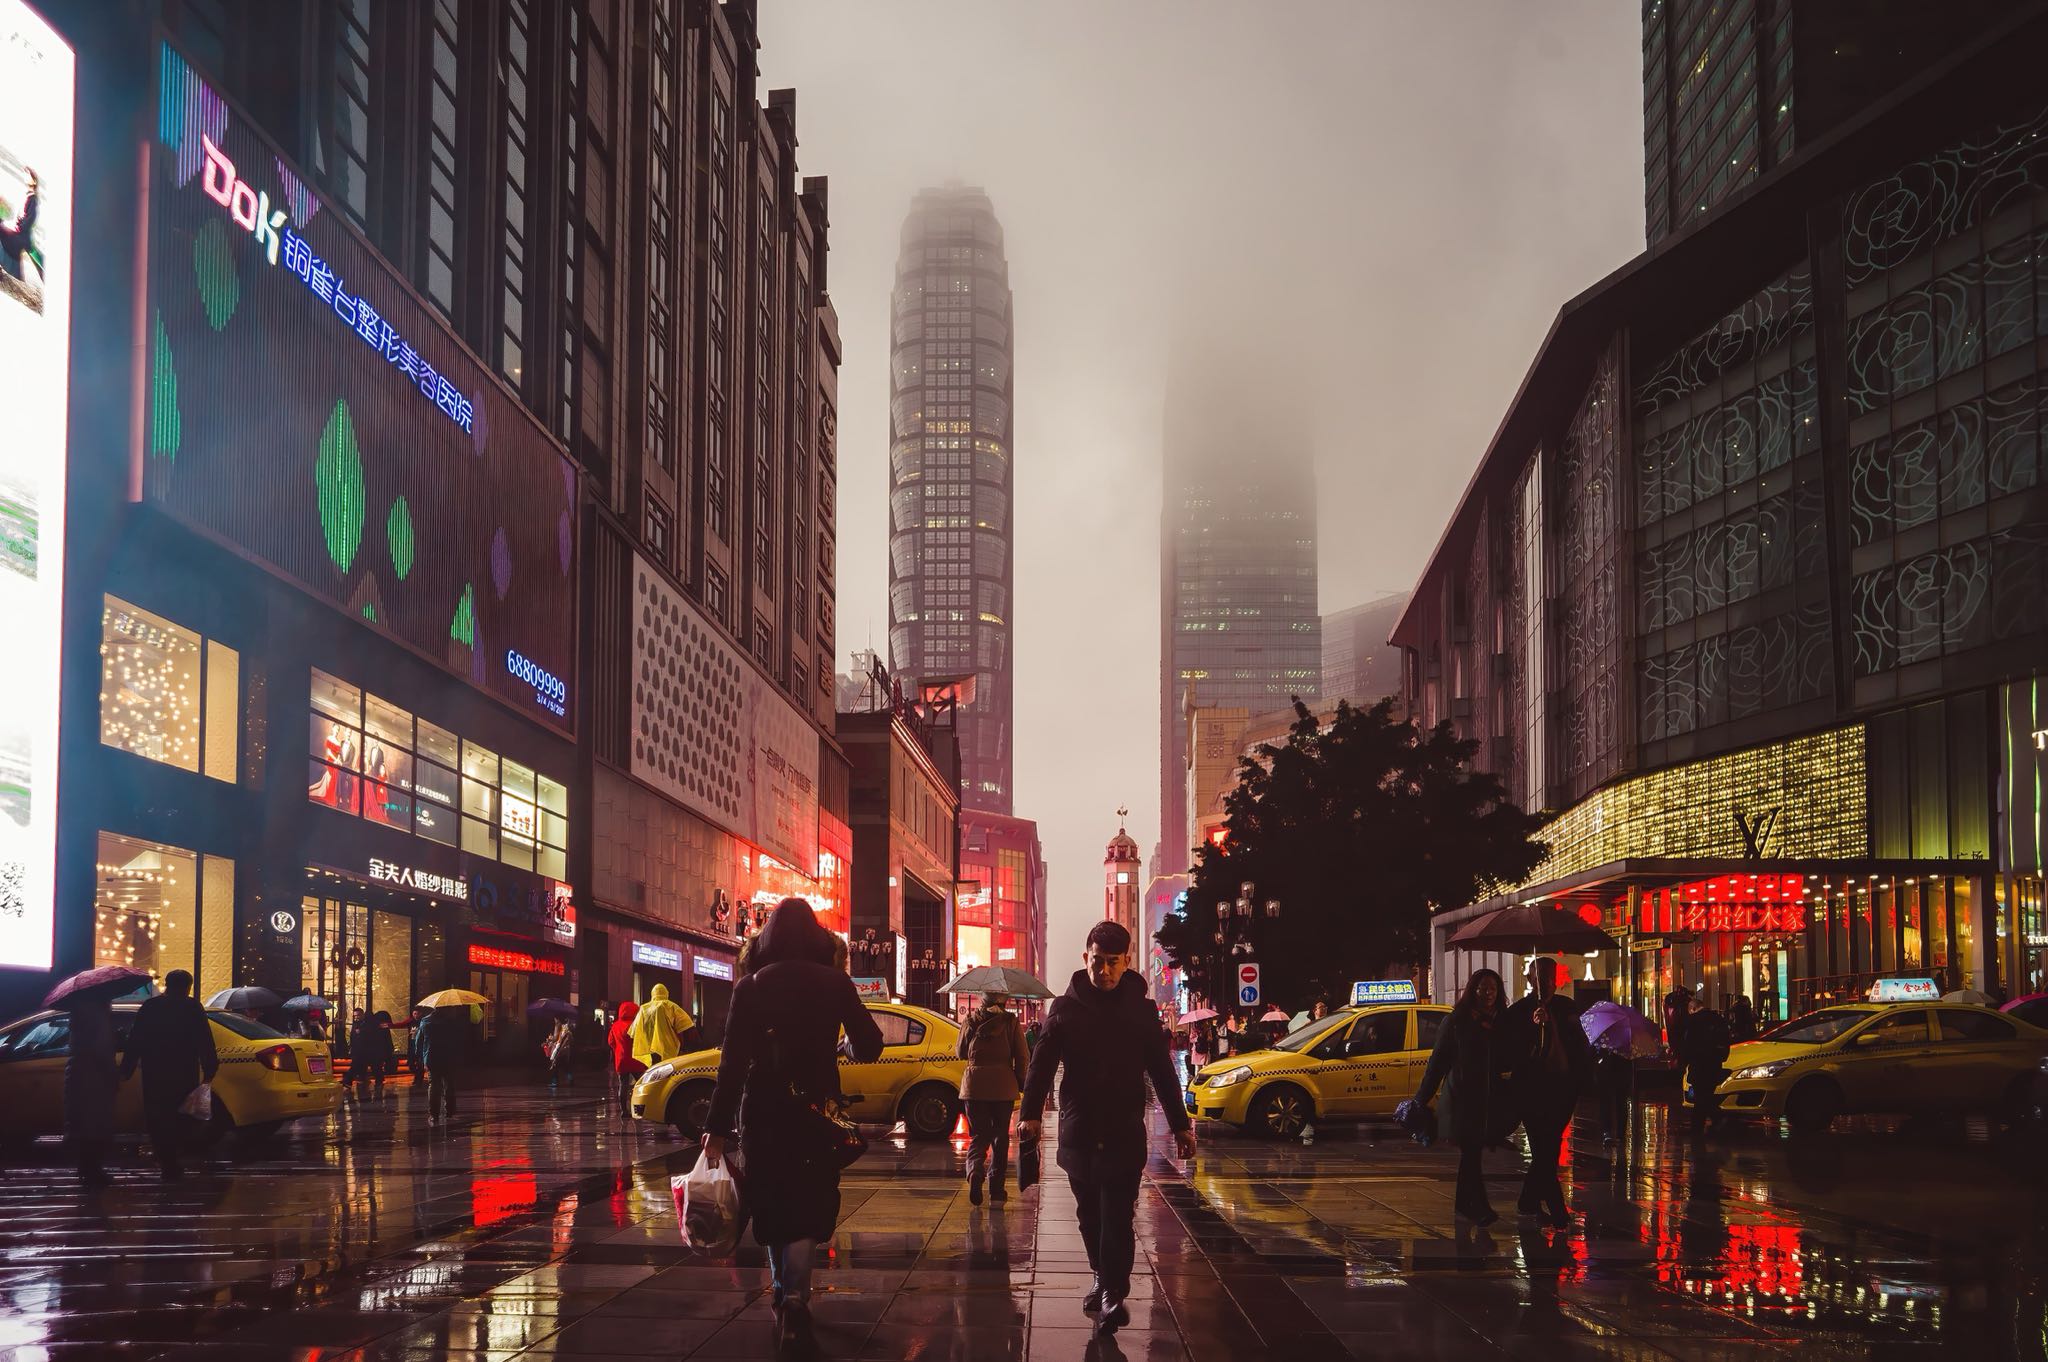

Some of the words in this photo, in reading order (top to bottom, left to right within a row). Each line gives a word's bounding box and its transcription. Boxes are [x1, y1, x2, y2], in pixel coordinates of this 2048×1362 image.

[283, 229, 474, 435] 铜雀台整形美容医院
[507, 649, 565, 704] 68809999
[368, 857, 468, 900] 金夫人婚纱摄影
